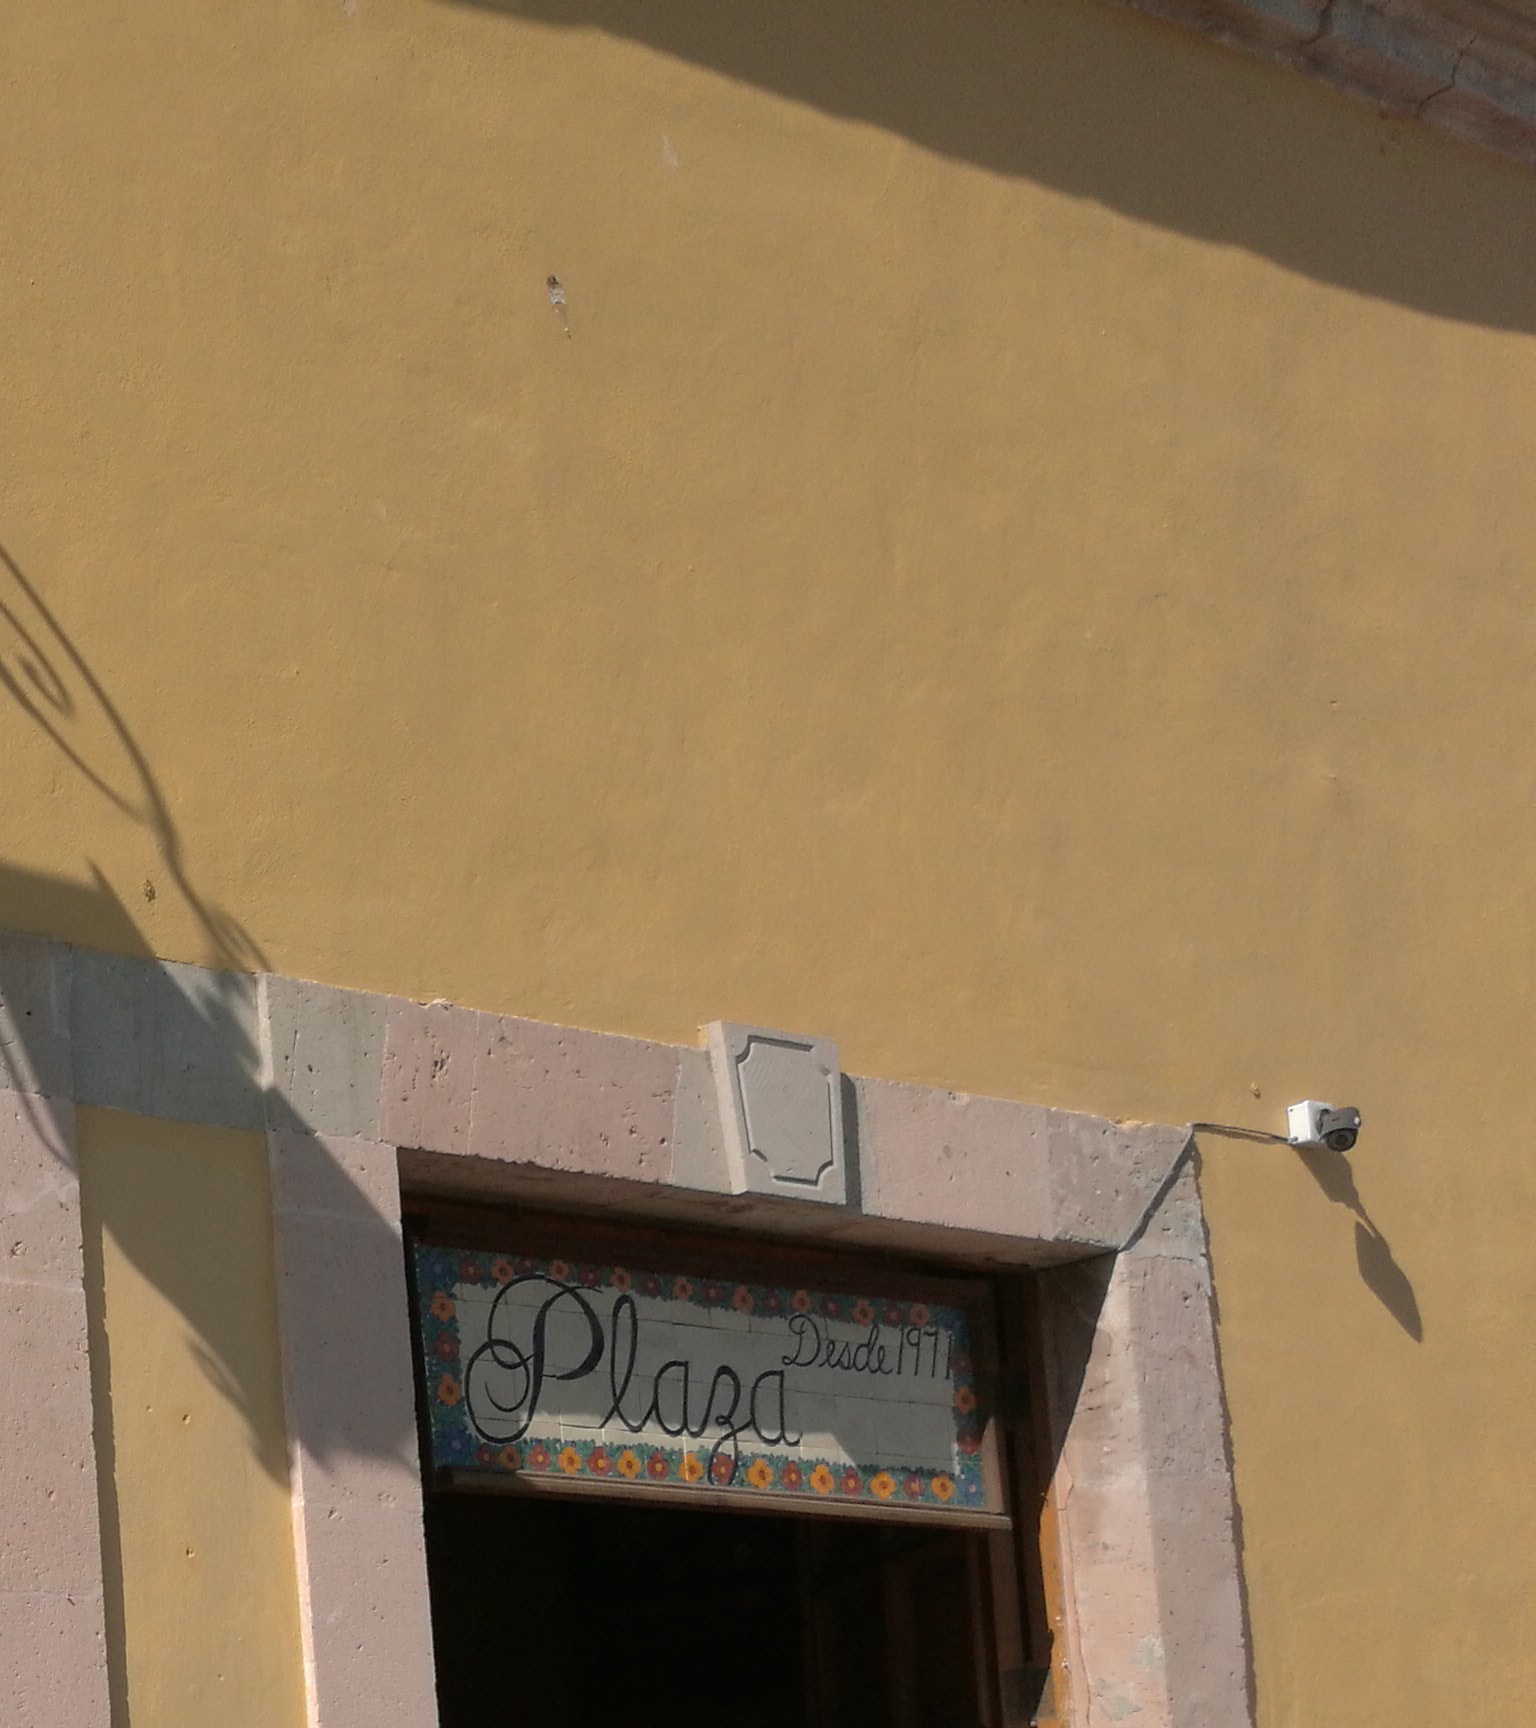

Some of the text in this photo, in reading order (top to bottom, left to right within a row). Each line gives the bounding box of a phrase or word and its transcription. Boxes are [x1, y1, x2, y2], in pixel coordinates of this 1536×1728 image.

[465, 1273, 803, 1486] Plaza
[781, 1313, 953, 1380] Desde 1971
